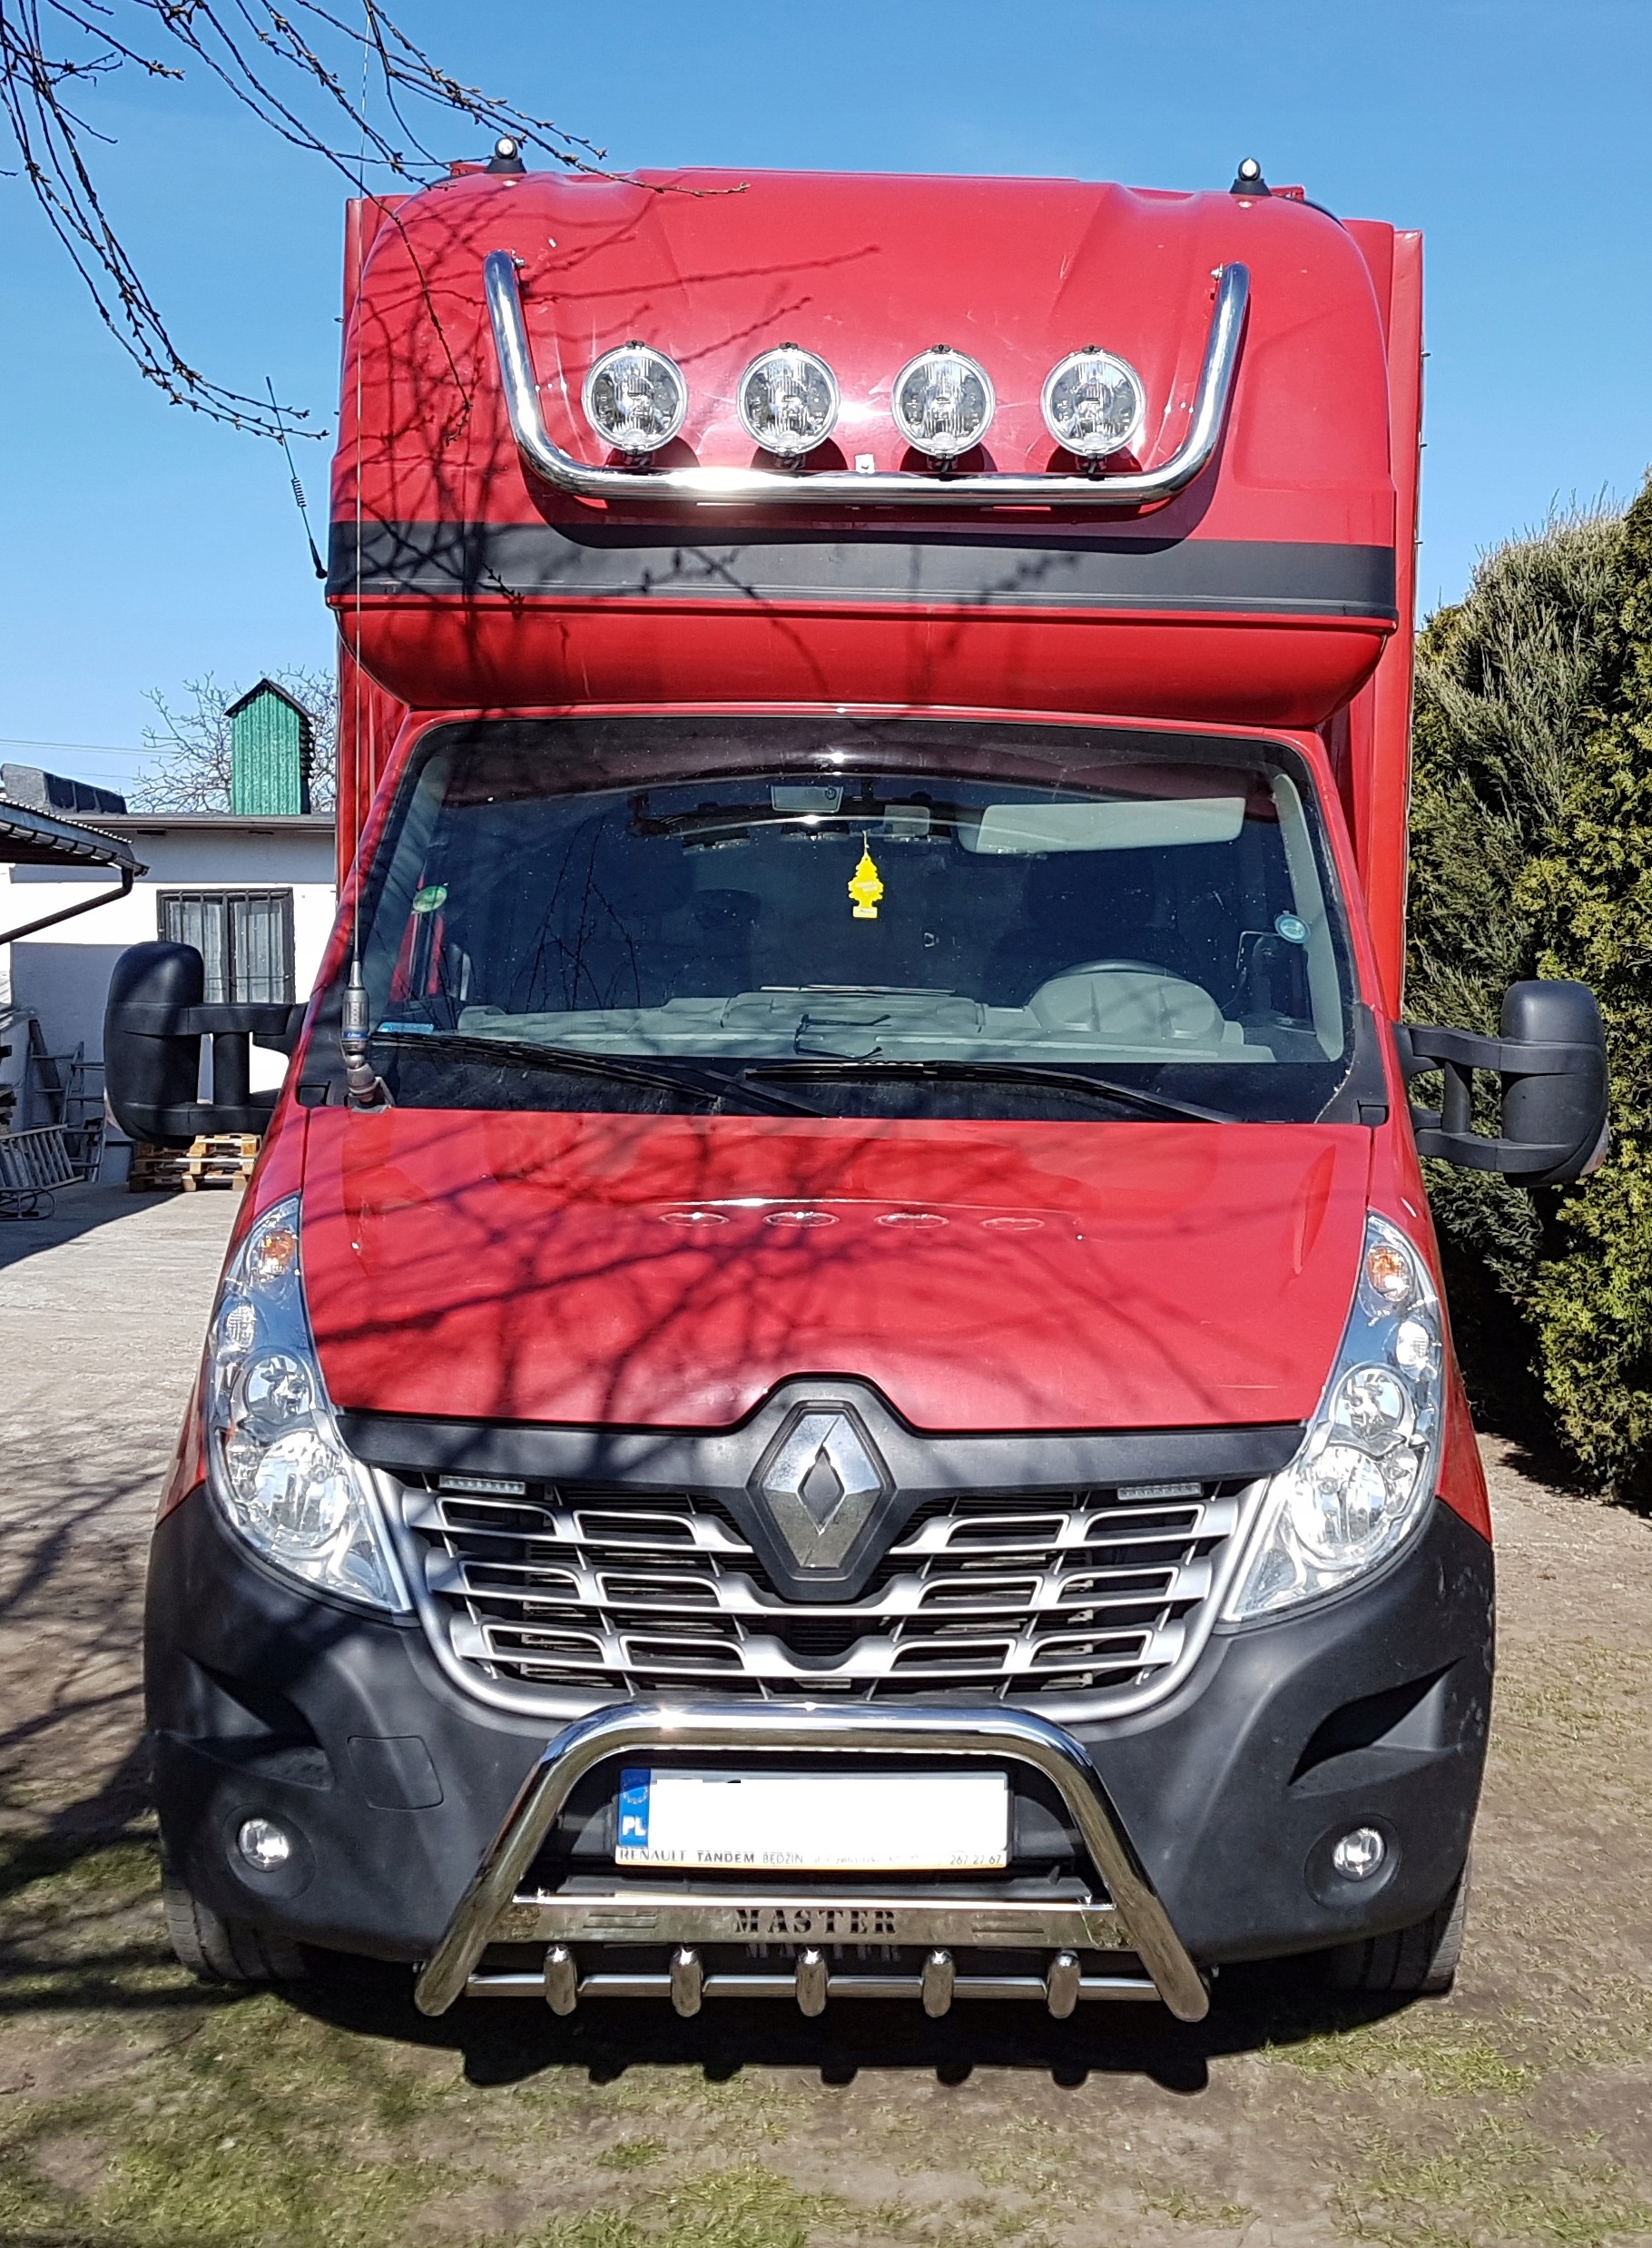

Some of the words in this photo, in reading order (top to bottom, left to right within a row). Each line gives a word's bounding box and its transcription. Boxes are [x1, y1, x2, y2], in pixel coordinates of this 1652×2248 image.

[622, 1816, 646, 1836] PL
[620, 1849, 685, 1861] RENAULT
[696, 1850, 755, 1863] TANDEM
[734, 1909, 896, 1934] MASTER
